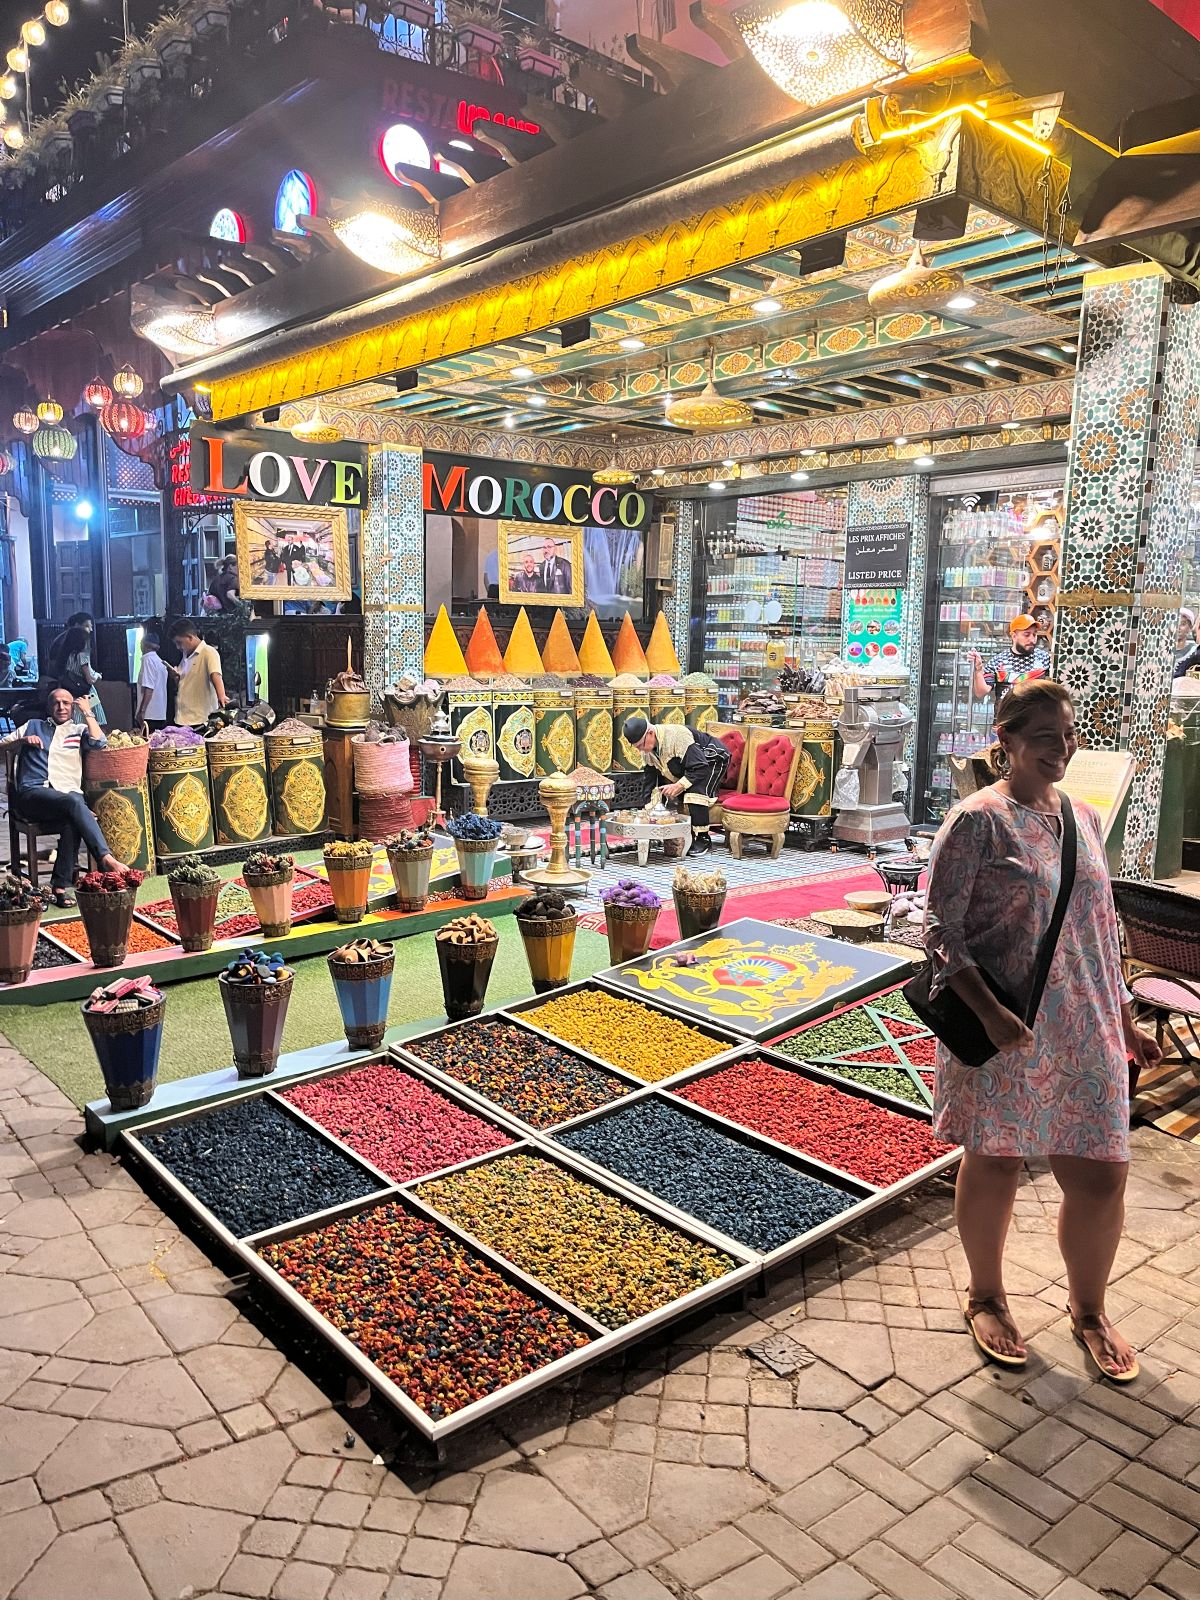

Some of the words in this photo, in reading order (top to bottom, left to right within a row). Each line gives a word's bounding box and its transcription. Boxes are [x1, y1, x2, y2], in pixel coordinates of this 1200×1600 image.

[202, 436, 363, 505] LOVE
[422, 463, 646, 528] MOROCCO
[848, 535, 860, 543] LES
[860, 534, 875, 543] PRIX
[848, 571, 877, 580] LISTED
[878, 570, 902, 579] PRICE
